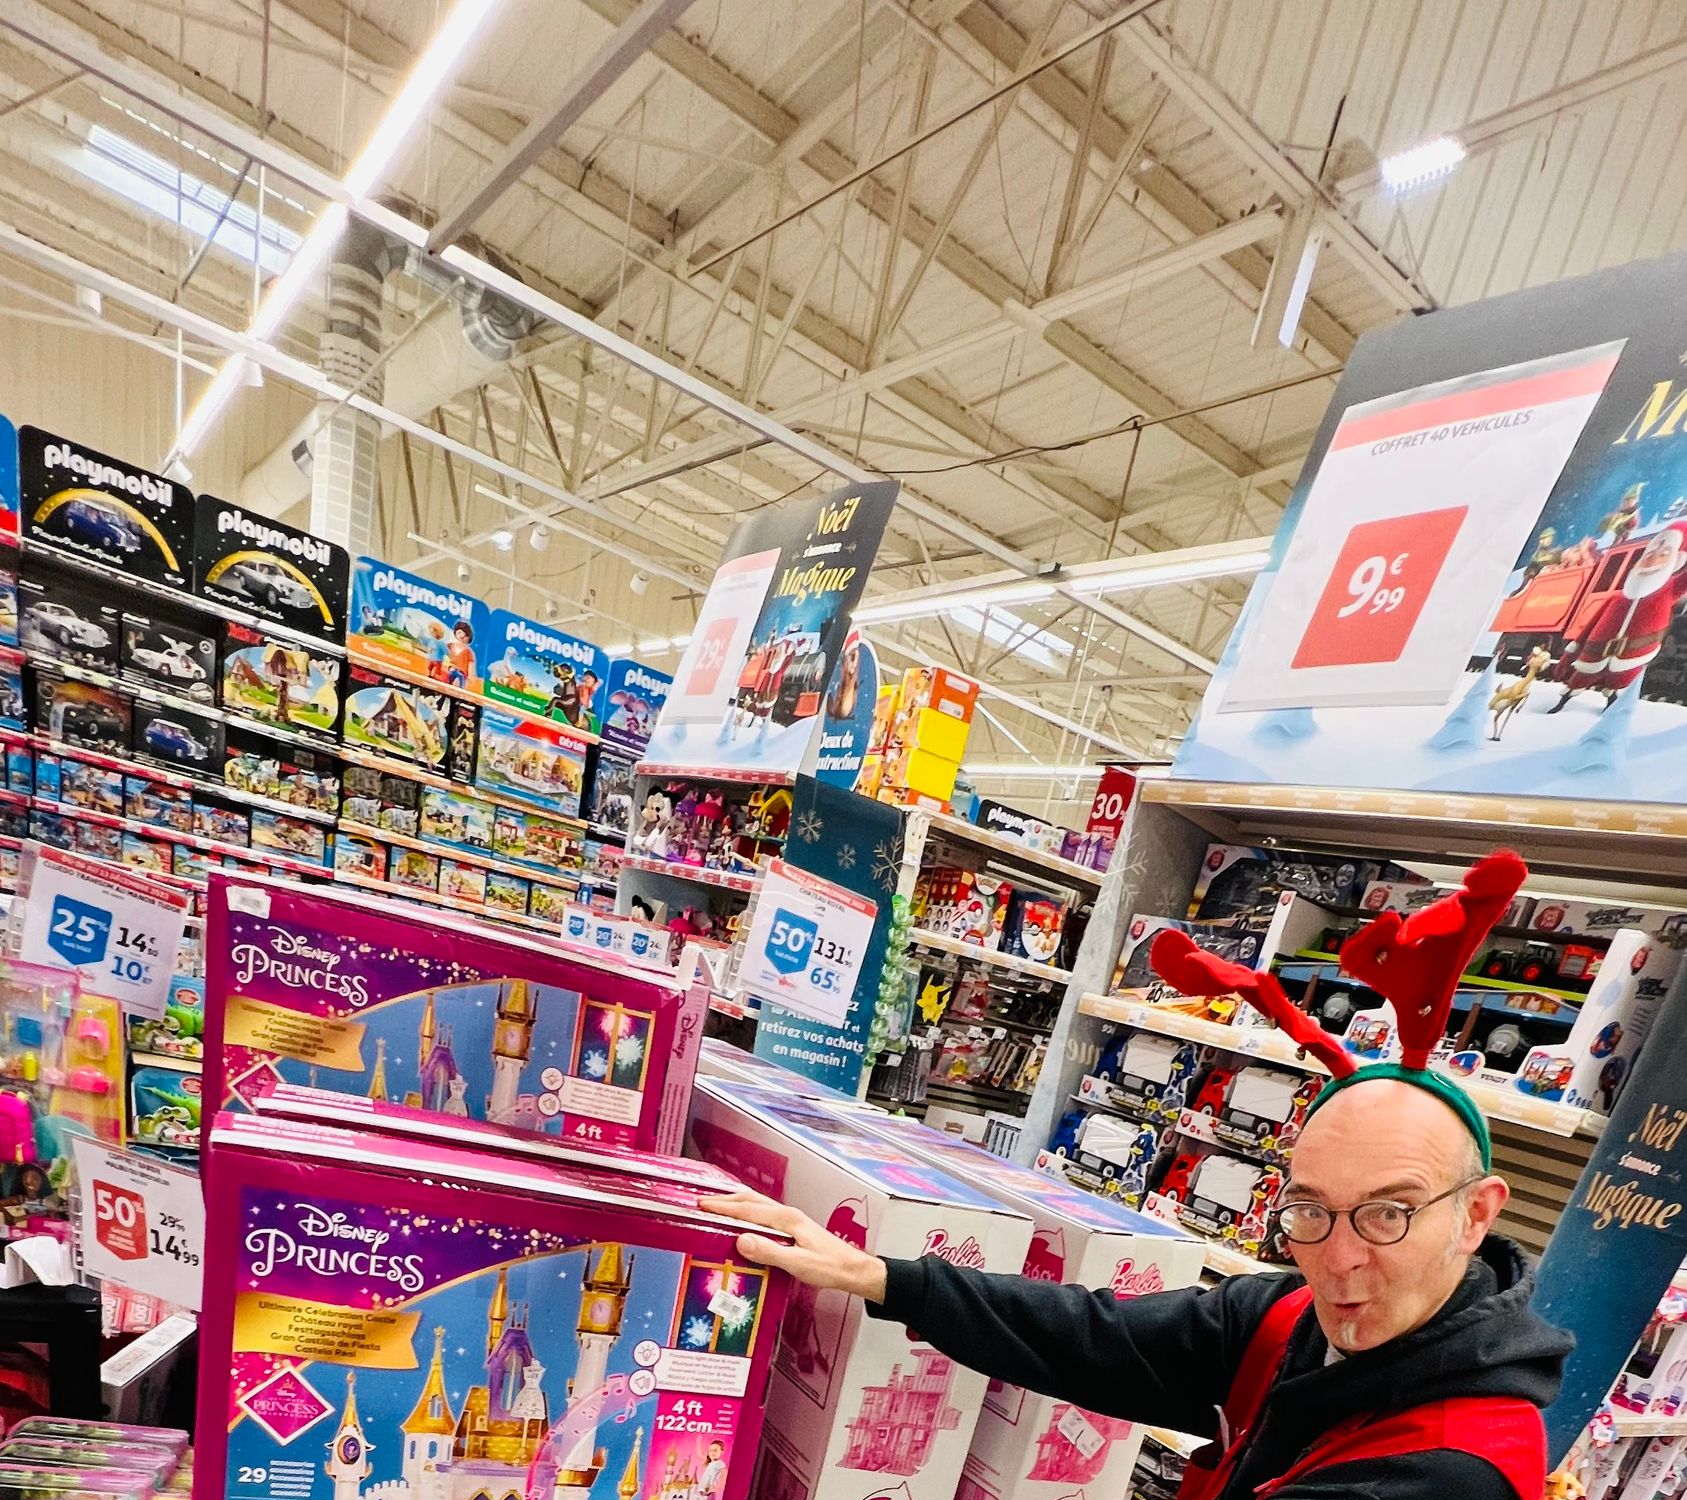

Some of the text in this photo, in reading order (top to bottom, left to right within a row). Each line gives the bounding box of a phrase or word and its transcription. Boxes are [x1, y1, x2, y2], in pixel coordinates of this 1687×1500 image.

[1371, 409, 1534, 456] COFFRET 40 VEHICULES
[44, 444, 173, 507] playmobil
[217, 510, 331, 566] playmobil
[806, 496, 861, 541] Noël
[373, 569, 472, 620] playmobil
[774, 561, 856, 607] Magique
[505, 621, 595, 666] playmobil
[231, 944, 369, 1007] PRINCESS
[761, 1019, 864, 1053] retirez vos achats
[773, 1045, 788, 1056] en
[789, 1048, 841, 1067] magasin
[1576, 1171, 1683, 1230] Magique
[245, 1227, 425, 1292] PRINCESS
[1112, 1258, 1164, 1295] Barbie
[258, 1300, 302, 1314] Ultimate
[304, 1306, 363, 1321] Celebration
[270, 1332, 296, 1343] Gran
[337, 1340, 350, 1349] de
[351, 1341, 382, 1352] Fiesta
[238, 1466, 267, 1483] 29
